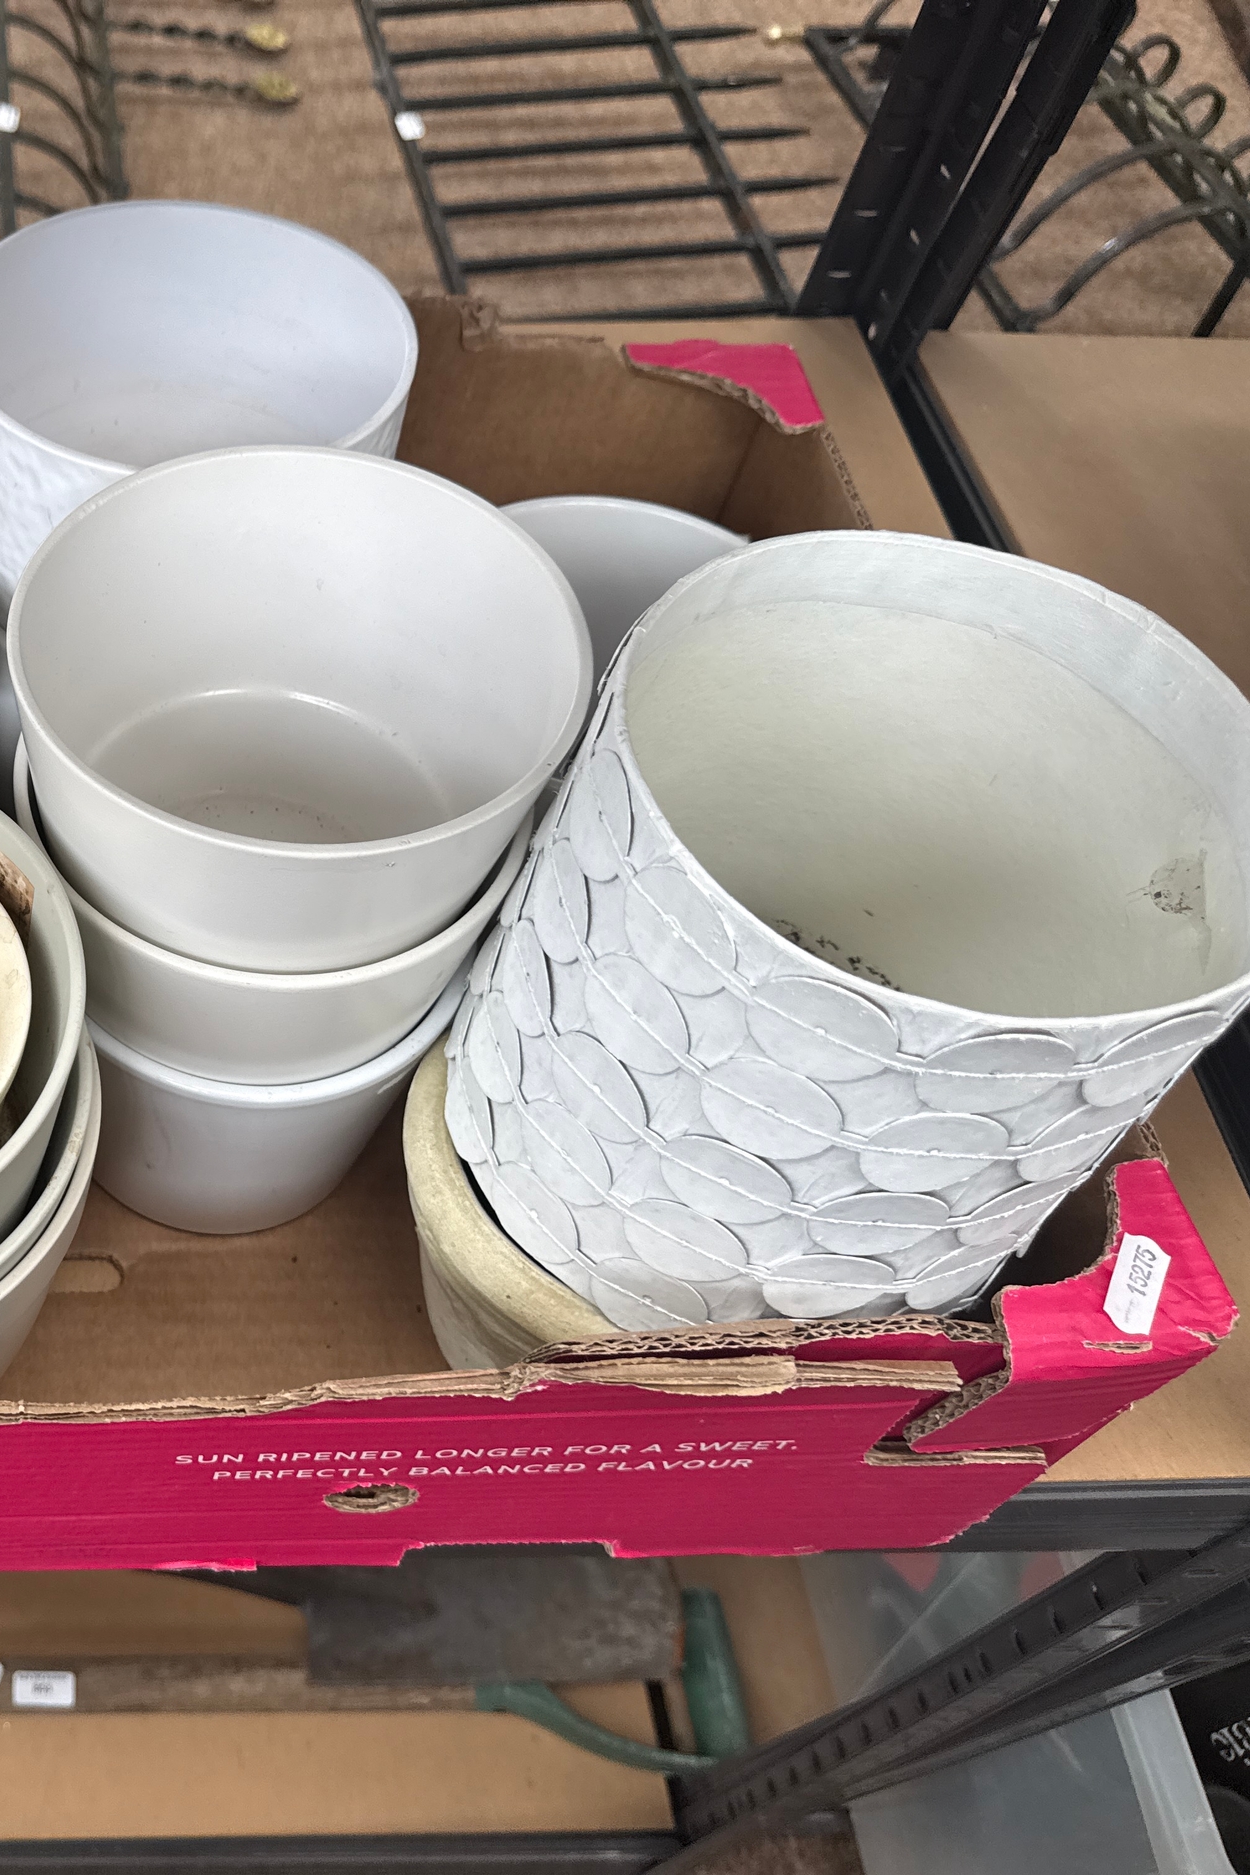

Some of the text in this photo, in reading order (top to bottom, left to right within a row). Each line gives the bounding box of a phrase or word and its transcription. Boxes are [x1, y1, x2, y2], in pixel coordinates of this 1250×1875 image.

[1126, 1244, 1157, 1297] 15275
[175, 1453, 244, 1464] SUN
[257, 1450, 402, 1462] RIPENED
[414, 1447, 553, 1460] LONGER
[563, 1444, 632, 1456] FOR
[639, 1443, 663, 1454] A
[212, 1458, 754, 1480] PERFECTLY BALANCED FLAVOUR
